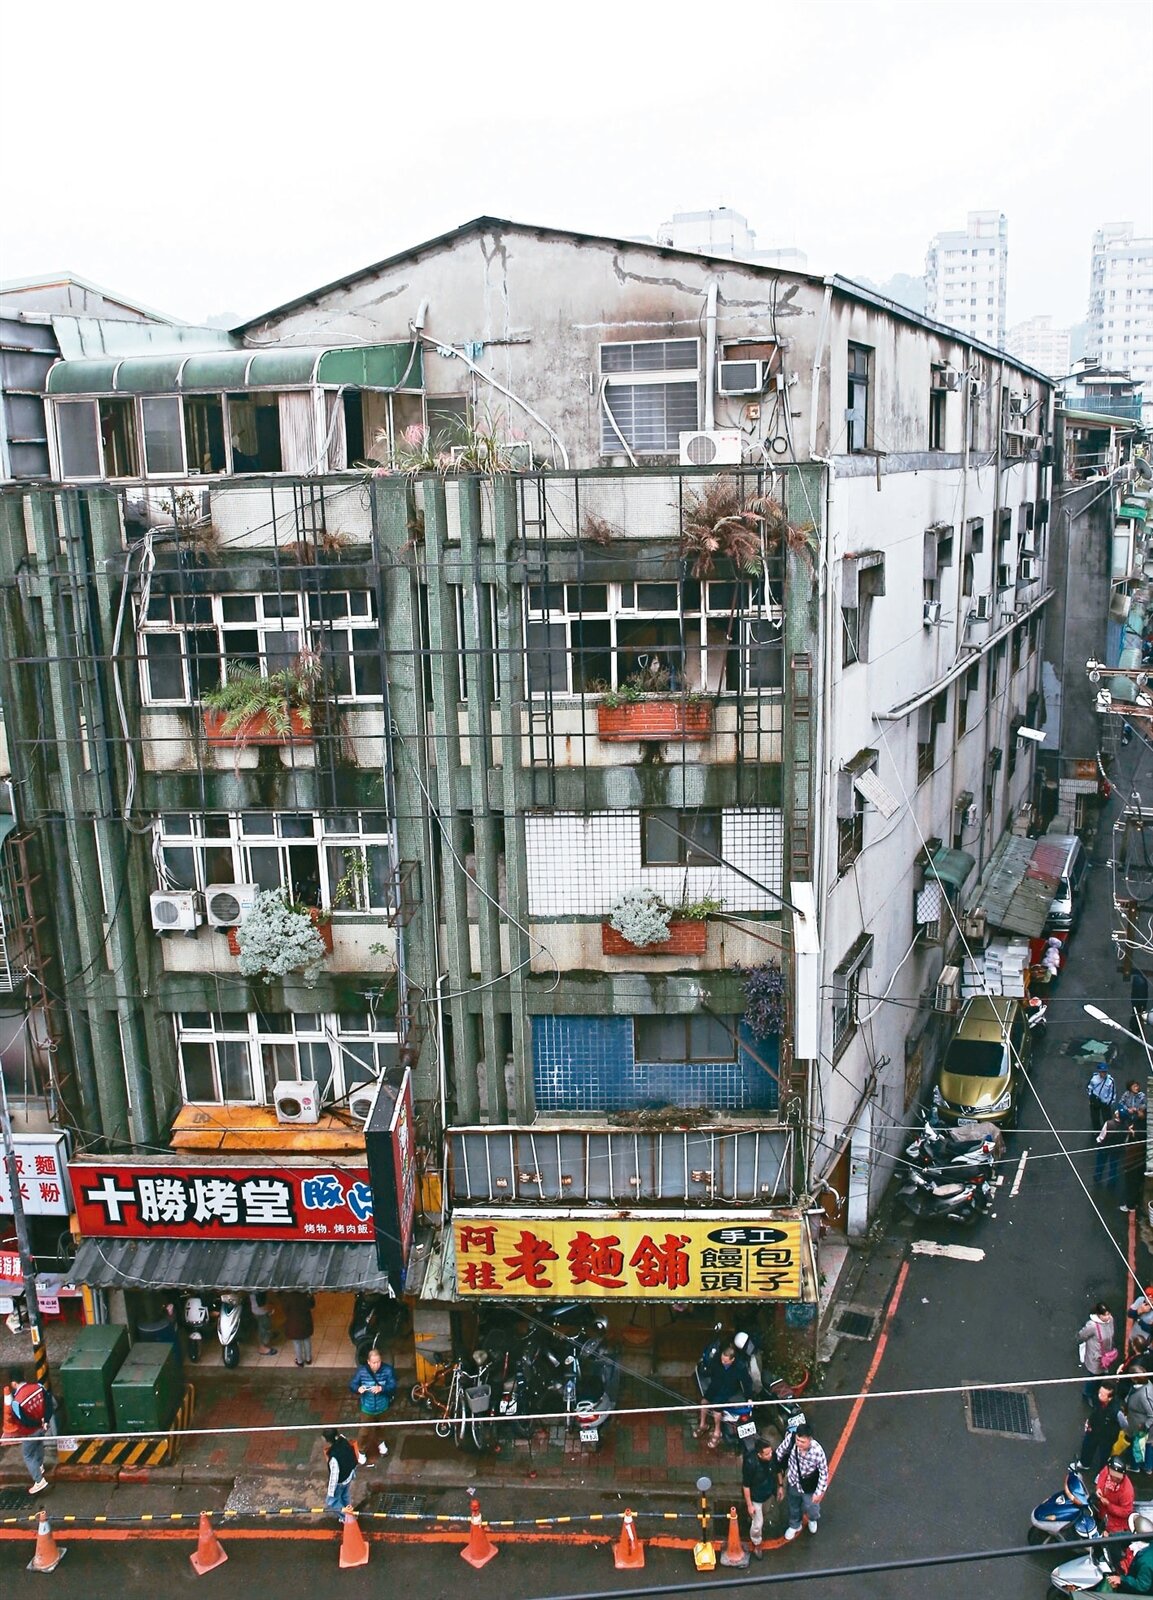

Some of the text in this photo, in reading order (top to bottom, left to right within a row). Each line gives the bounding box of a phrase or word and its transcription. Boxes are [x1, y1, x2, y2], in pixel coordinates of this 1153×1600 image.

[88, 1177, 293, 1224] 十勝烤堂
[460, 1226, 503, 1291] 阿桂
[720, 1229, 775, 1243] 手工
[701, 1246, 742, 1292] 饅頭
[751, 1247, 793, 1292] 包子
